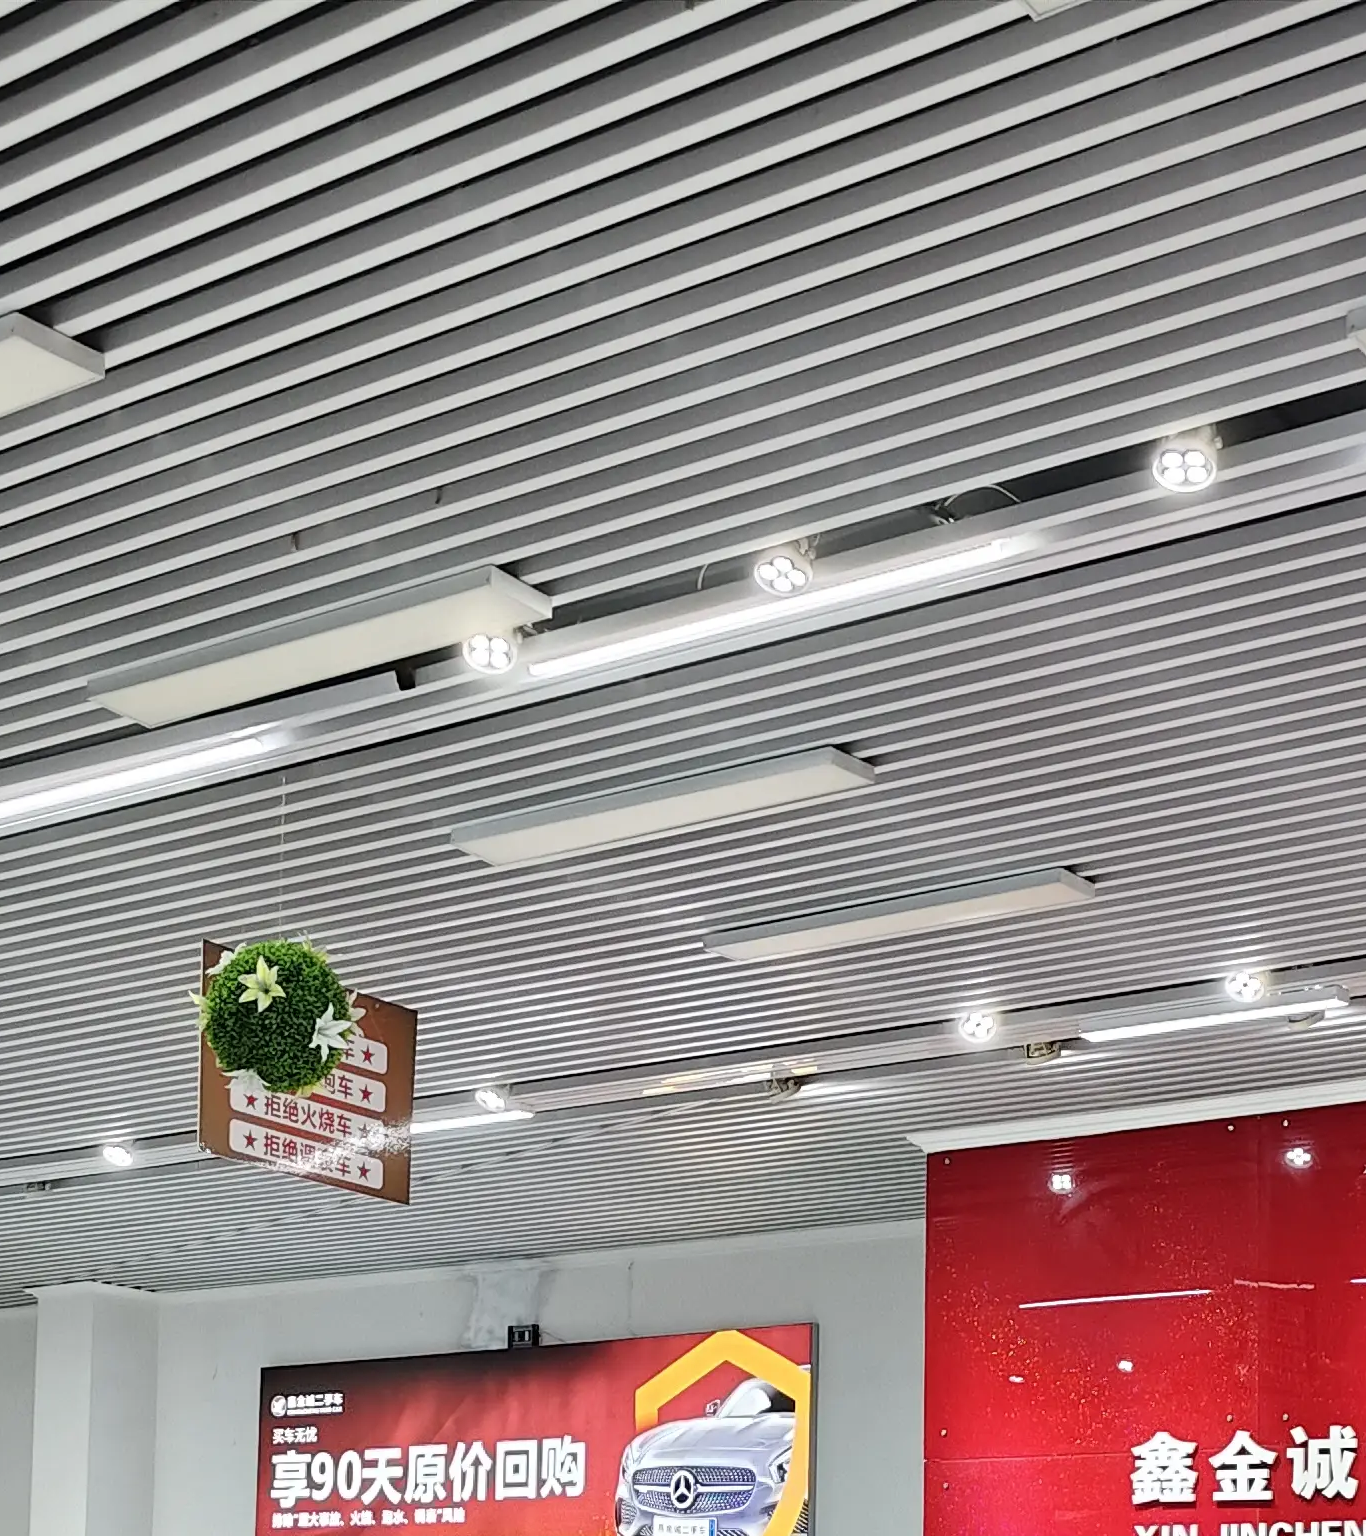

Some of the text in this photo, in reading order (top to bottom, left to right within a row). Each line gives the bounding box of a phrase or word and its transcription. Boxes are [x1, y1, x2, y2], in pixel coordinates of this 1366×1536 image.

[264, 1094, 353, 1138] 拒绝火烧车
[263, 1134, 353, 1178] 拒绝调车
[272, 1426, 318, 1445] 买车无忧
[270, 1434, 587, 1509] 享90天原价回购
